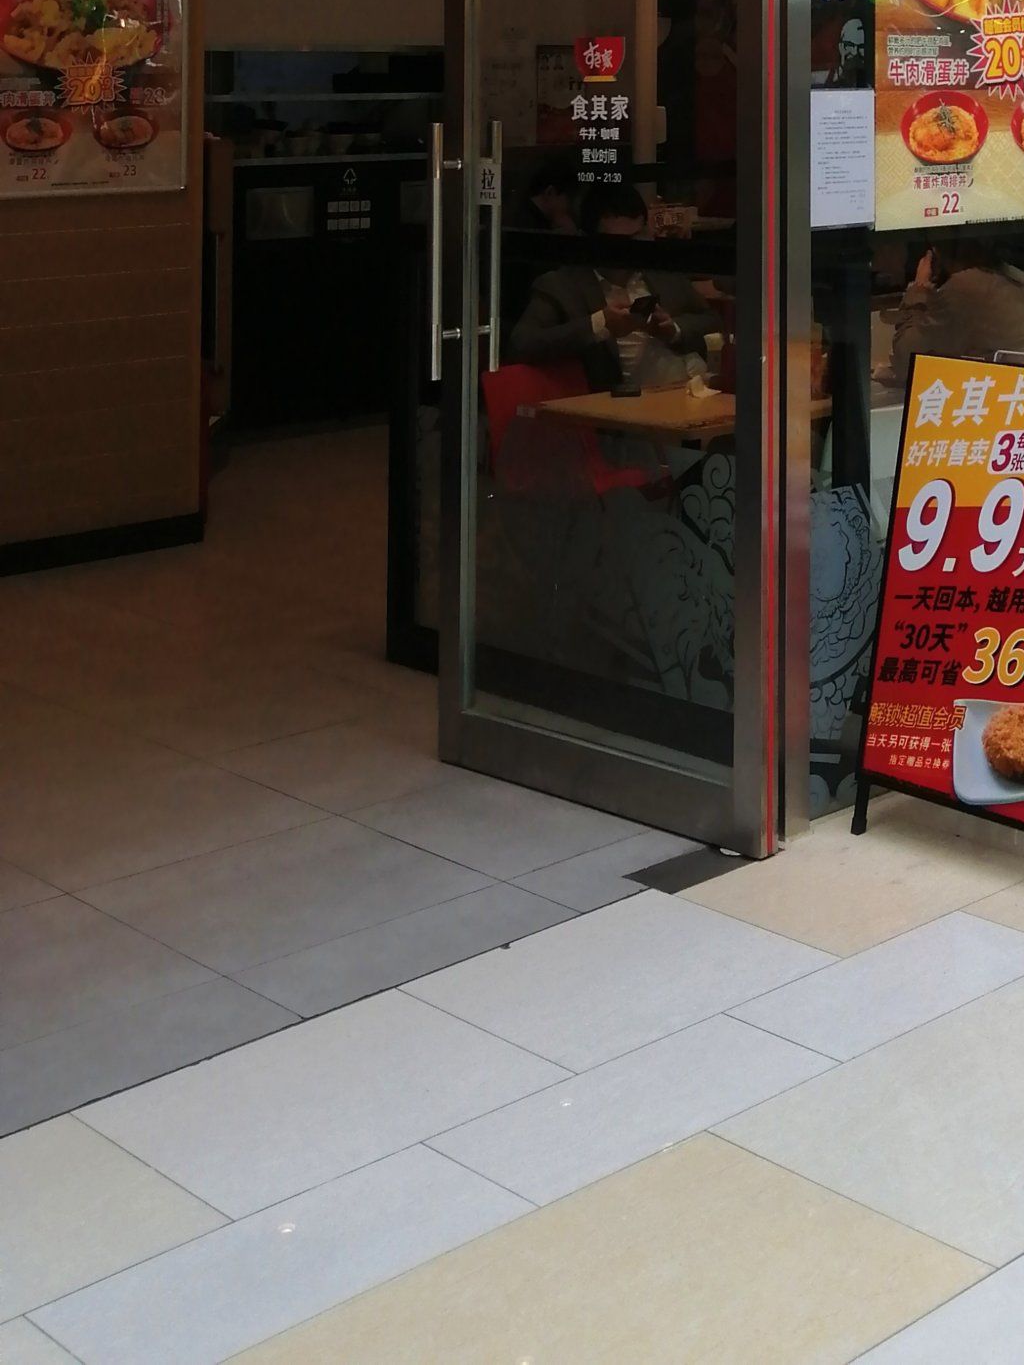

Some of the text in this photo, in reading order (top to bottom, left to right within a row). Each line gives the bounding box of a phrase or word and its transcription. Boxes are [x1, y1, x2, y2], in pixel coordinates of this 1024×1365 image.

[583, 42, 614, 71] すき家
[889, 58, 970, 85] 牛肉滑蛋丼
[570, 95, 629, 121] 食其家
[581, 149, 618, 164] 营业时间
[481, 169, 495, 190] 拉
[577, 172, 595, 182] 10:00
[603, 172, 622, 183] 21:30
[942, 193, 960, 214] 22
[905, 438, 990, 468] 好评售卖
[991, 433, 1015, 472] 3
[867, 701, 968, 732] 解锁超值会员
[866, 733, 951, 753] 当天另可获得一张
[889, 754, 950, 771] 指定赠品兑换券
